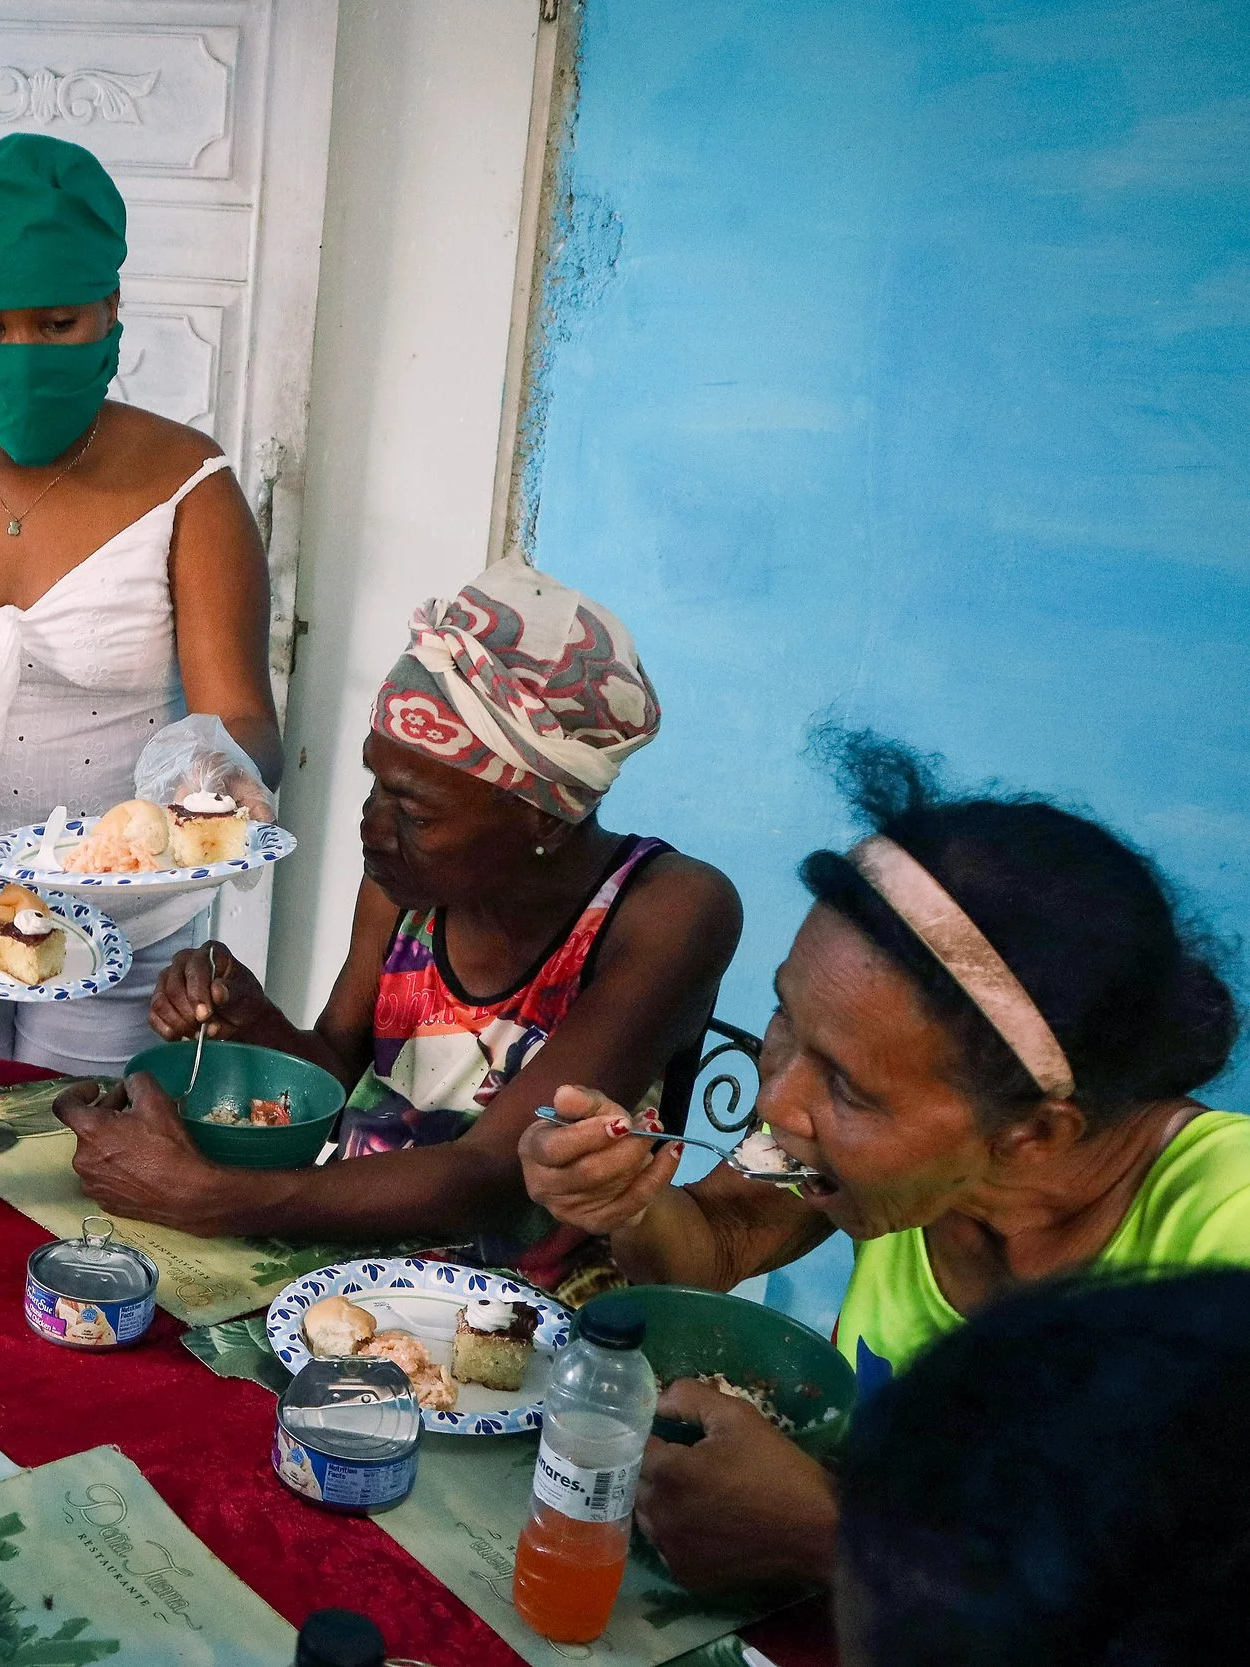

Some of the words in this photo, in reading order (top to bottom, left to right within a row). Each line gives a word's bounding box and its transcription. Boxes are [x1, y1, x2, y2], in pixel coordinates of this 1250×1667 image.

[327, 1470, 346, 1480] Facts
[328, 1463, 358, 1475] Nutrition
[538, 1457, 585, 1493] nares.
[77, 1533, 150, 1607] RESTAURANTE
